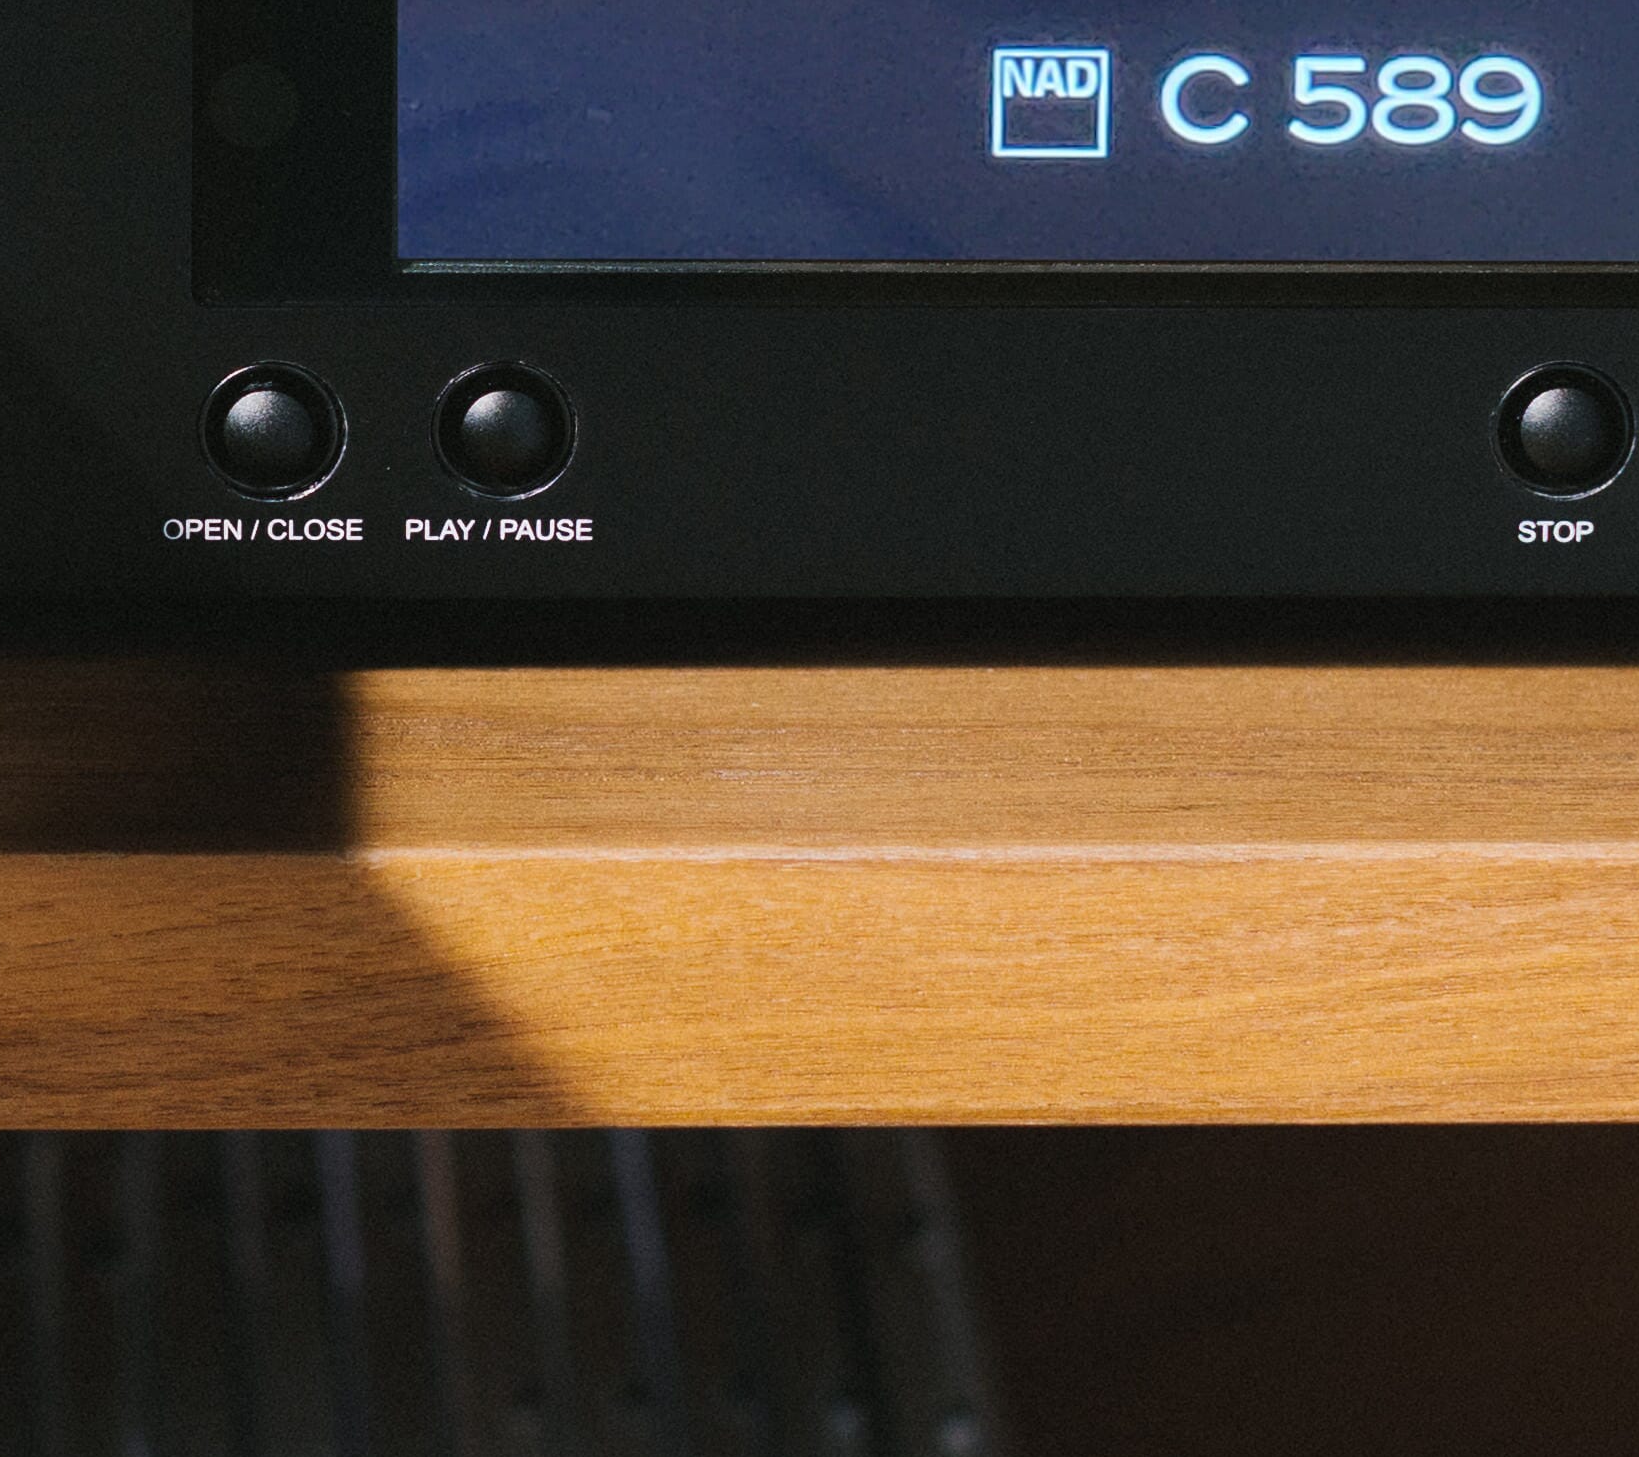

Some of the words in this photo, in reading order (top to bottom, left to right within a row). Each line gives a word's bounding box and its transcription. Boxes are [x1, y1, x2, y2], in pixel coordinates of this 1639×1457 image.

[1002, 58, 1098, 97] NAD
[1162, 57, 1248, 143] C
[1289, 57, 1542, 144] 589
[163, 519, 242, 541] OPEN
[268, 519, 363, 541] CLOSE
[406, 519, 475, 541] PLAY
[500, 519, 593, 541] PAUSE
[1518, 521, 1594, 543] STOP
